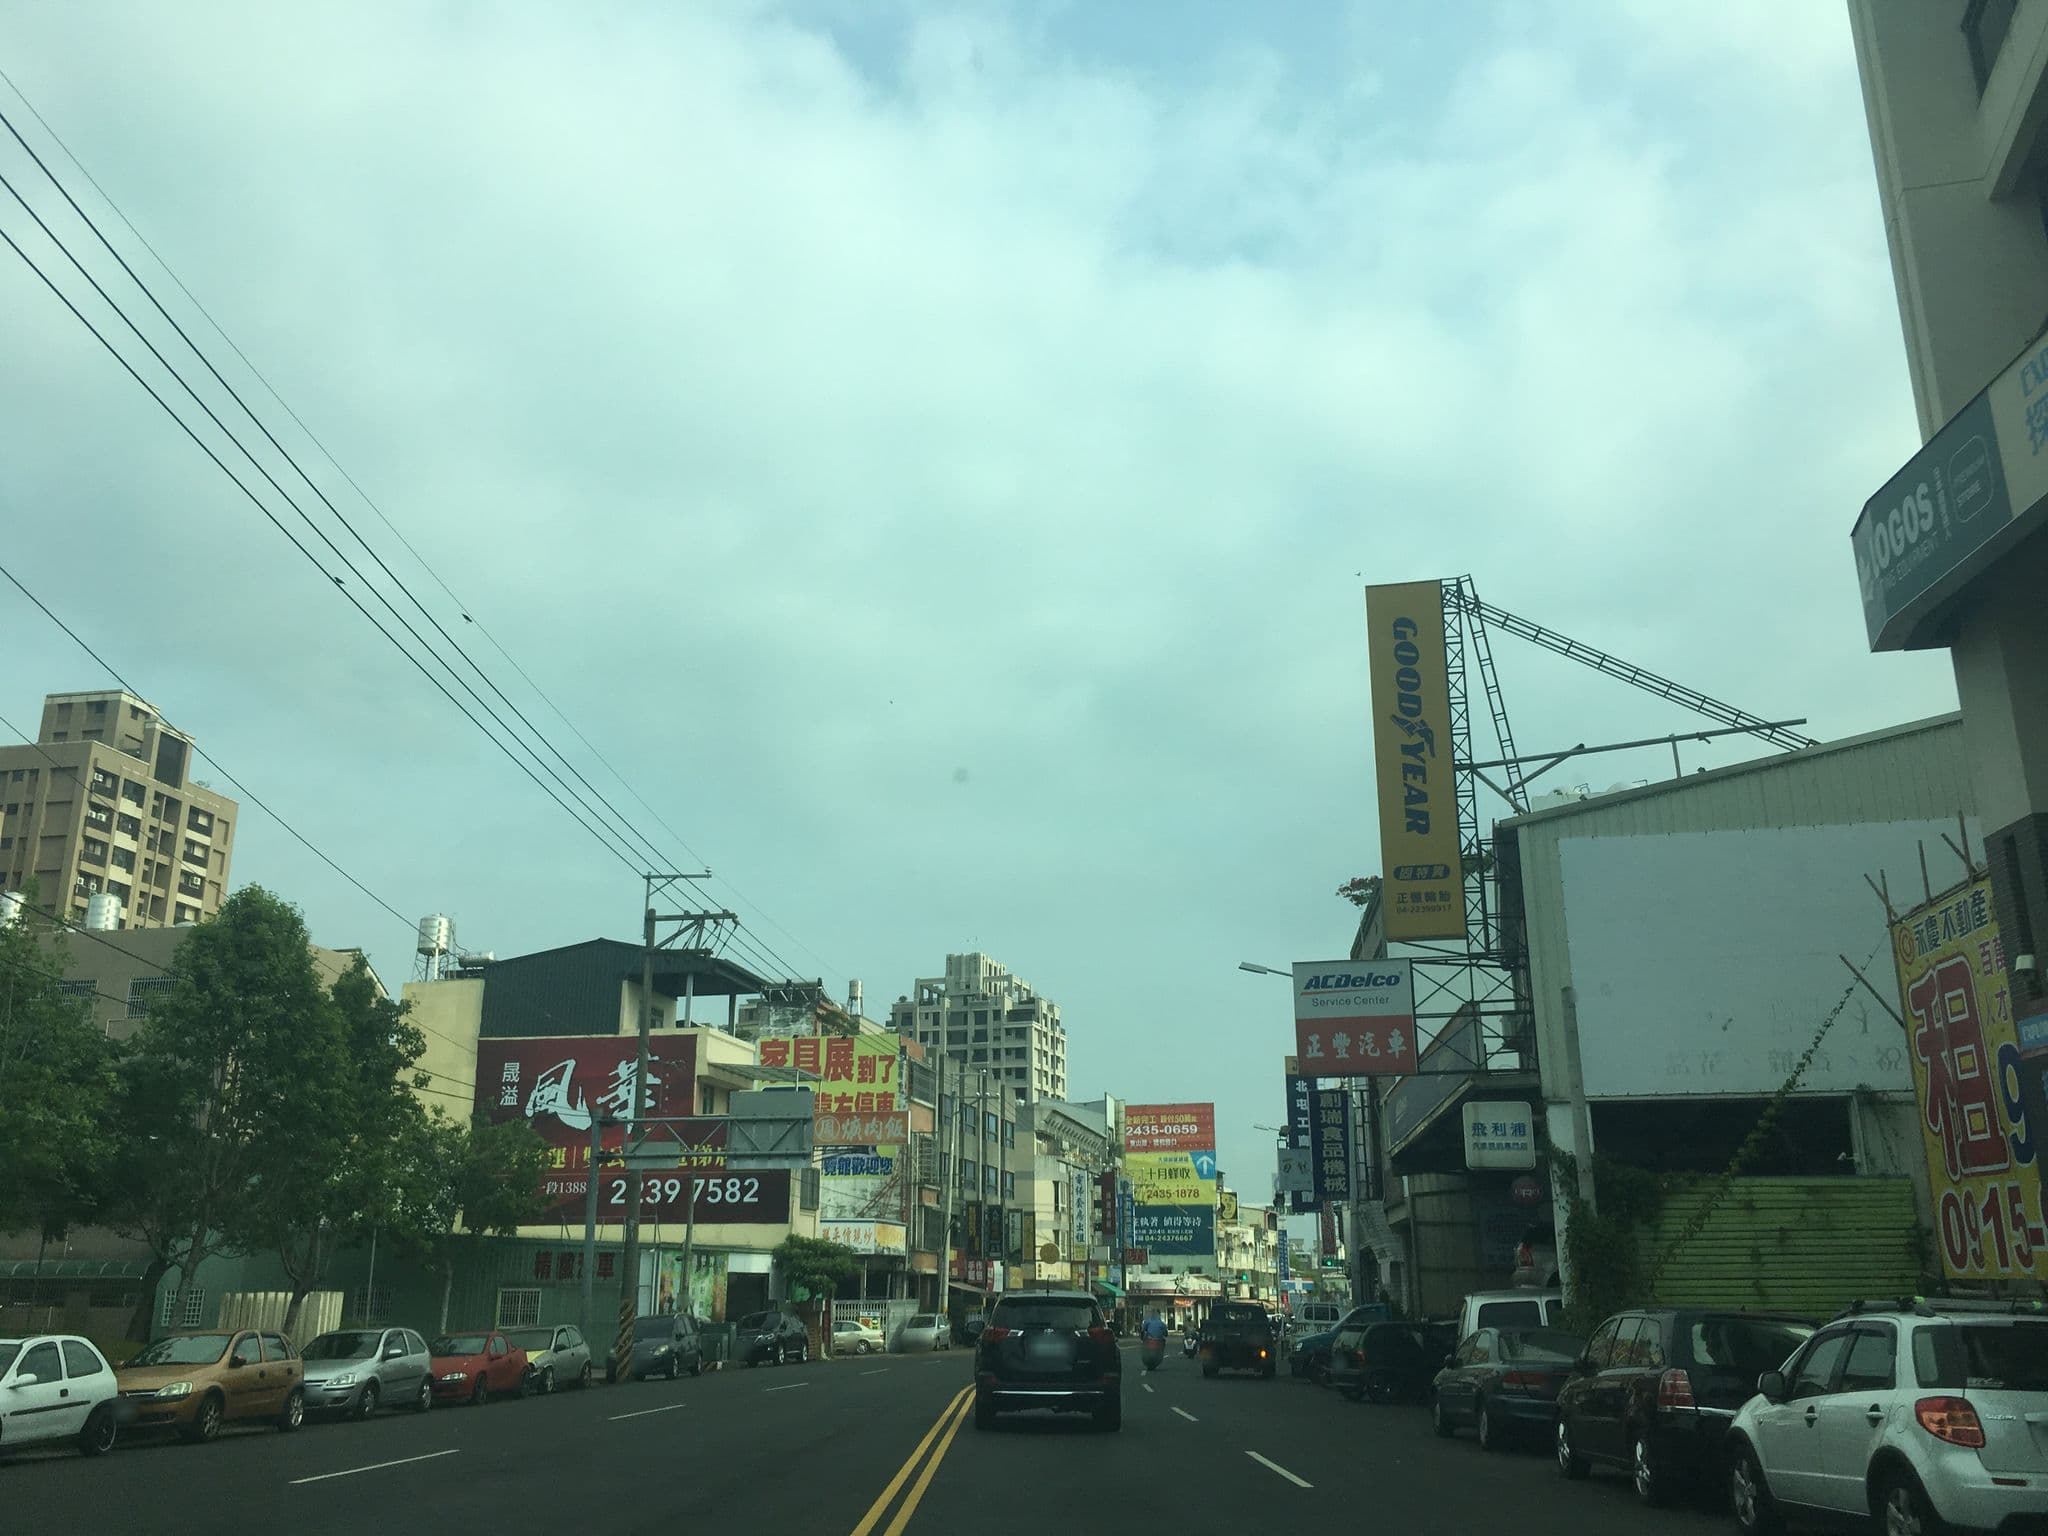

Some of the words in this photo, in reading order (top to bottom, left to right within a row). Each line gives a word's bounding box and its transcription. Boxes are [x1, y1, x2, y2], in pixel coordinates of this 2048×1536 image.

[1391, 616, 1430, 836] GOODYEAR
[1303, 971, 1401, 990] ACDelco
[1311, 996, 1351, 1008] Service
[1353, 995, 1390, 1007] Center
[1906, 953, 2011, 1183] 租
[1126, 1125, 1198, 1136] 2435-0659
[1472, 1122, 1527, 1137] 飛利浦
[610, 1178, 681, 1205] 239
